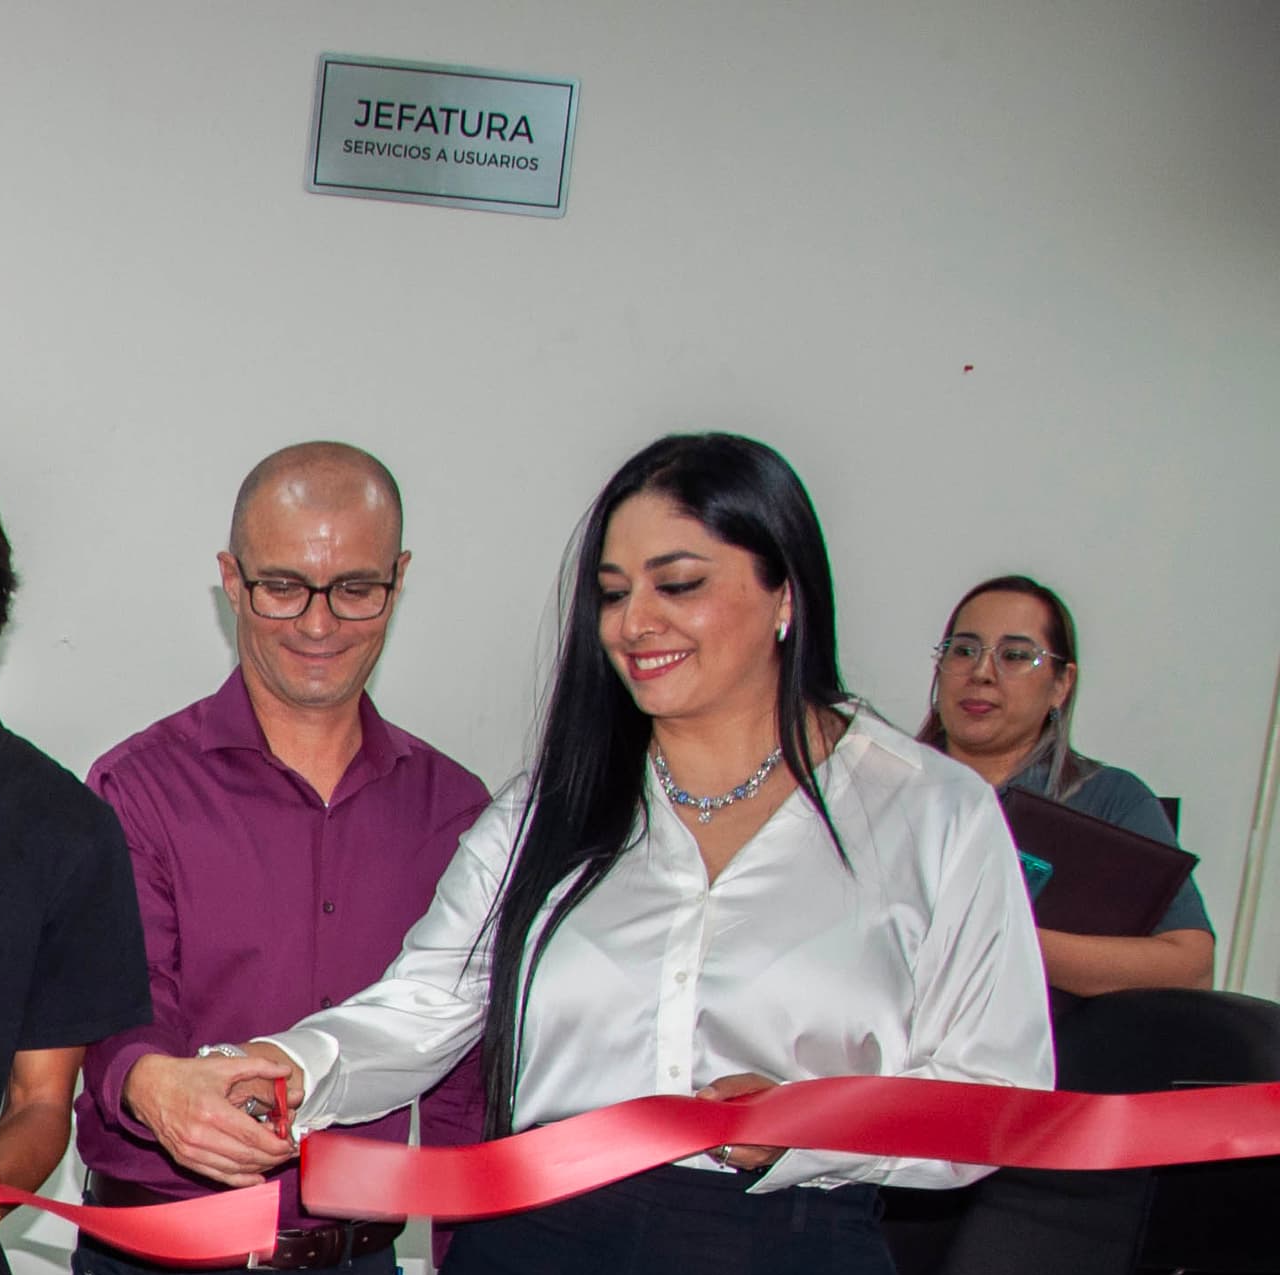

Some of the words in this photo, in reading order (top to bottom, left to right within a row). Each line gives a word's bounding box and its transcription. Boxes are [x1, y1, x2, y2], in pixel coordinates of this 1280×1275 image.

[354, 99, 535, 144] JEFATURA
[342, 138, 432, 162] SERVICIOS
[435, 147, 448, 163] A
[453, 150, 540, 172] USUARIOS
